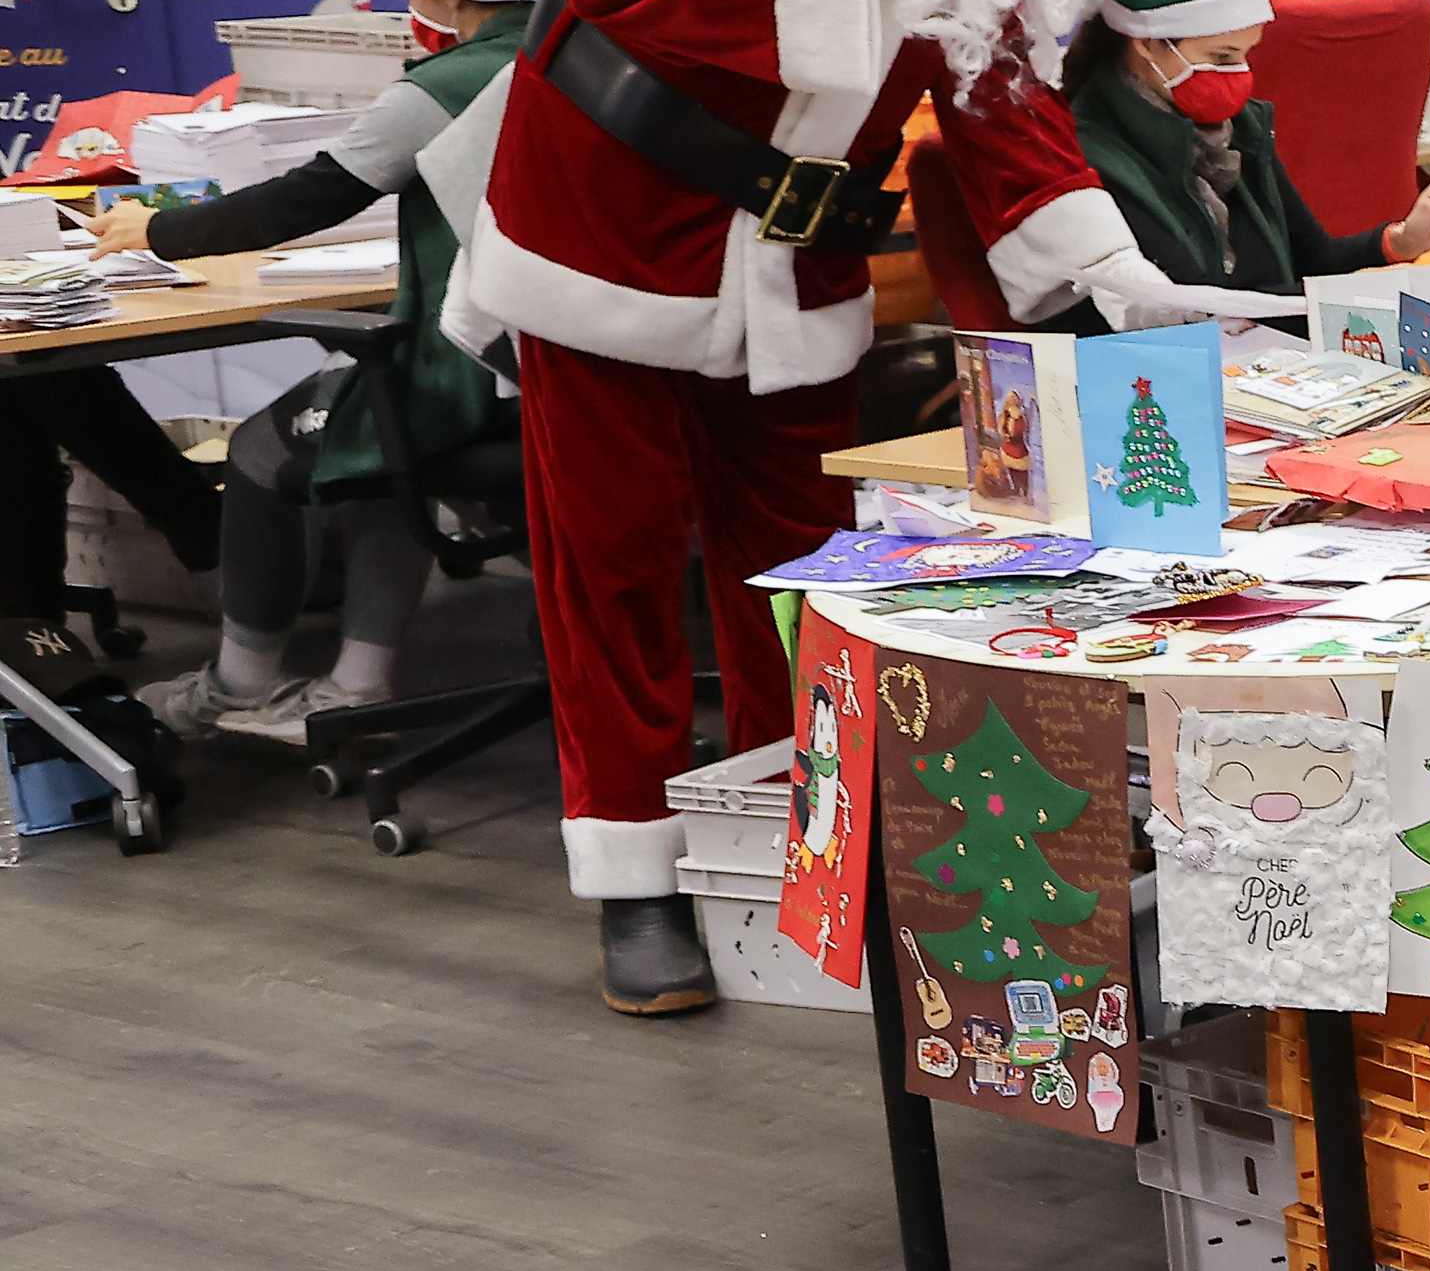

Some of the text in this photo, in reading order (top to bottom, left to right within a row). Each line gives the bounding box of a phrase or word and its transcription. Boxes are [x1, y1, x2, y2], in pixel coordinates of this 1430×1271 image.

[19, 47, 70, 66] au
[1235, 876, 1312, 915] Père
[1236, 911, 1314, 952] Noël
